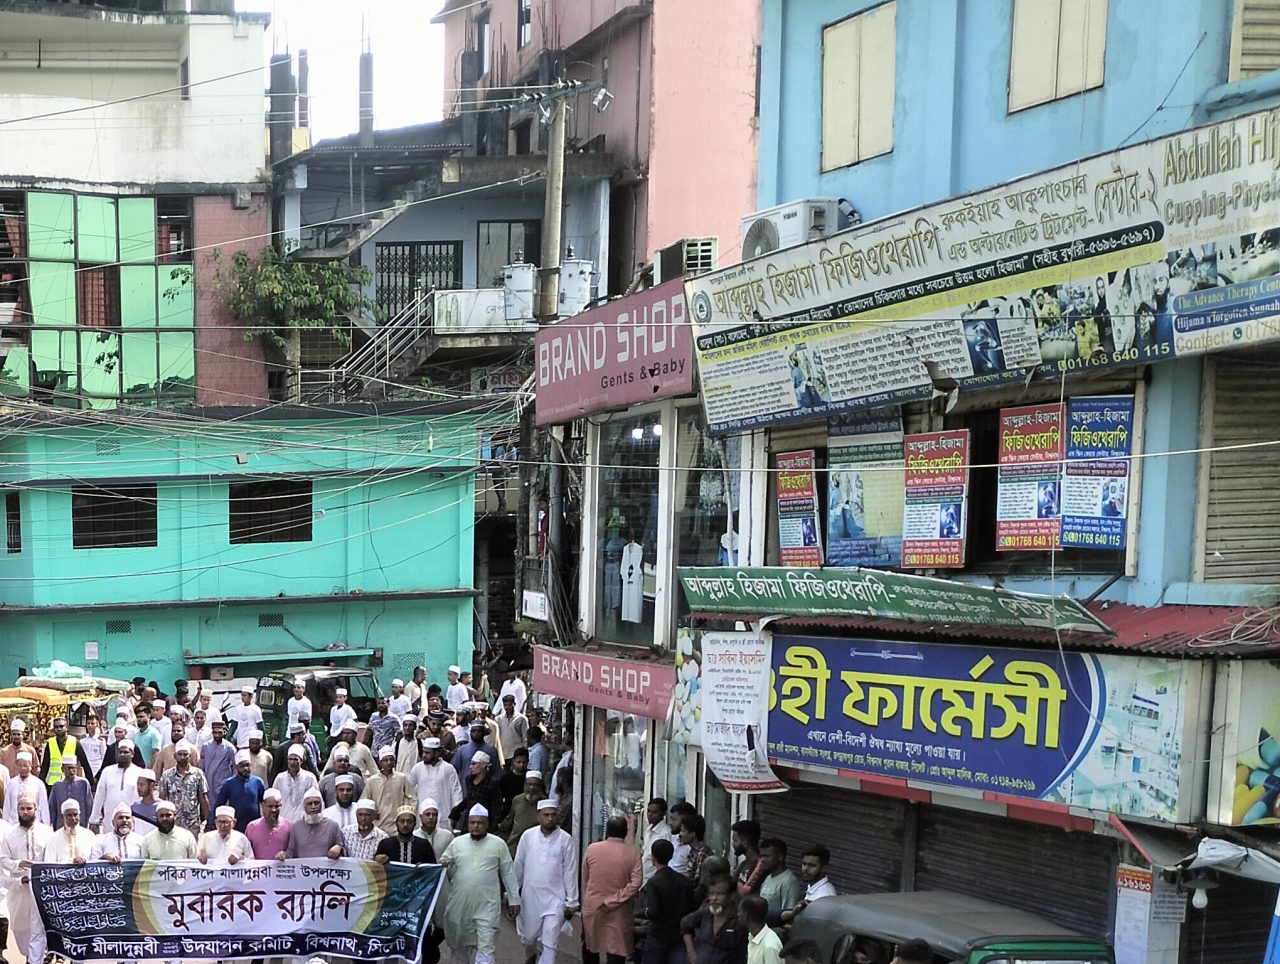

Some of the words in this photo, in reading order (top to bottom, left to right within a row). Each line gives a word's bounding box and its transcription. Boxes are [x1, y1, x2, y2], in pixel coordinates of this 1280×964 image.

[1163, 122, 1241, 186] Abdullah
[766, 261, 821, 307] হিজামা
[820, 217, 944, 292] ফিজিওথেরাপি
[1227, 281, 1259, 303] Therapy
[539, 321, 607, 388] BRAND
[617, 293, 686, 363] SHOP
[1067, 352, 1109, 371] 01768
[1112, 346, 1139, 363] 640
[1144, 343, 1170, 359] 115
[601, 371, 634, 390] Gents
[639, 365, 648, 380] &
[653, 357, 686, 377] Baby
[1003, 425, 1061, 453] ফিজিওথেরাপি
[1070, 425, 1128, 449] ফিজিওথেরাপি
[1034, 535, 1046, 546] 640
[1095, 533, 1107, 545] 640
[1109, 535, 1120, 546] 115
[947, 554, 959, 564] 115
[684, 575, 740, 601] আব্দুল্লাহ
[736, 571, 787, 600] হিজামা
[541, 653, 594, 685] BRAND
[600, 665, 651, 695] SHOP
[588, 684, 614, 697] Gents
[626, 691, 650, 705] Baby
[840, 654, 1067, 748] ফার্মেসী
[807, 730, 827, 743] এখানে
[828, 731, 867, 748] দেশী-বিদেশী
[924, 743, 946, 758] পাওয়া
[158, 866, 187, 881] পবিত্র
[162, 888, 267, 932] মুবারক
[274, 880, 357, 923] র‍্যালি
[91, 937, 161, 959] মীলাদুন্নবী
[181, 936, 244, 955] উদযাপন
